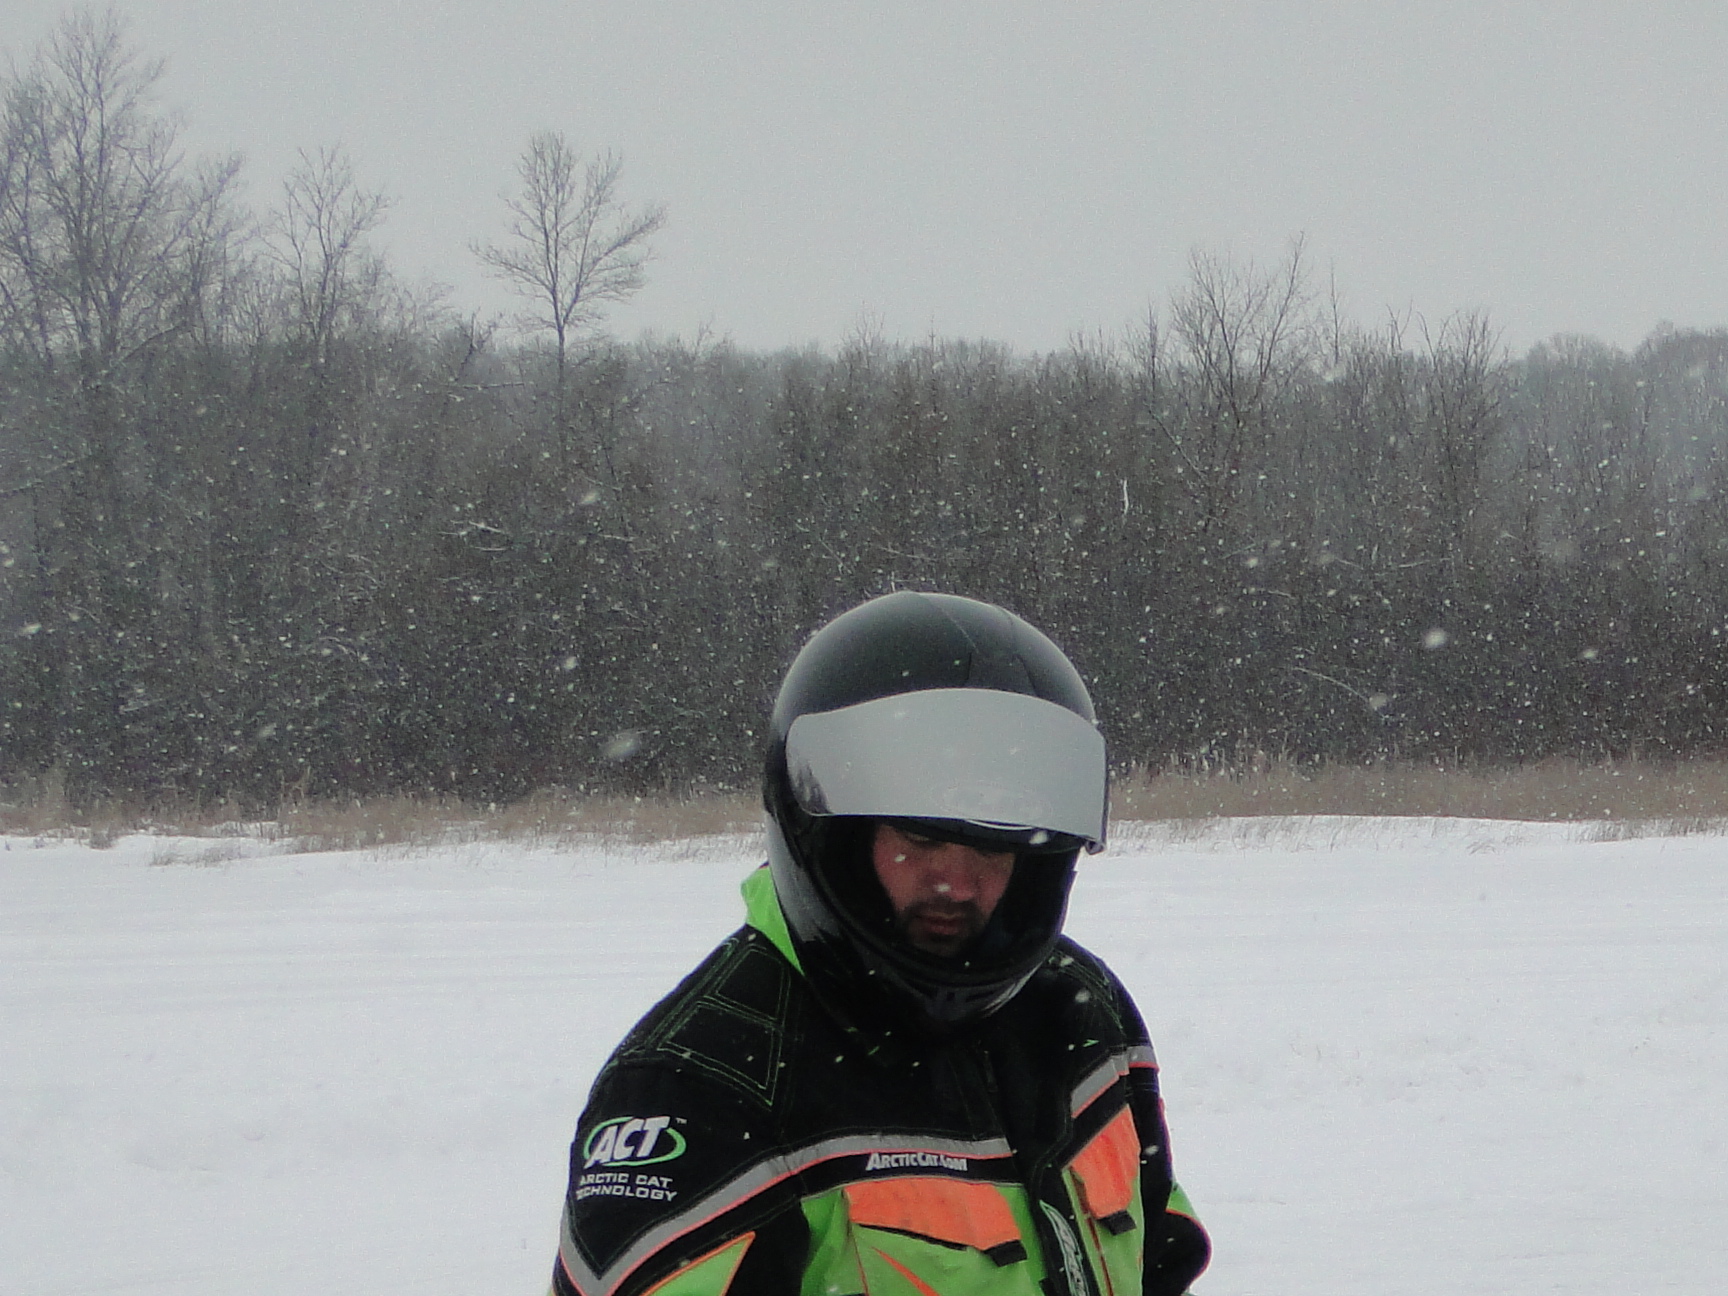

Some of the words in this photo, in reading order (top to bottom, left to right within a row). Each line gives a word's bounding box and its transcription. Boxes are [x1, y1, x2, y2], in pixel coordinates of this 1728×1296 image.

[583, 1115, 671, 1169] ACT
[580, 1172, 630, 1186] ARCTIC
[635, 1174, 673, 1188] CAT
